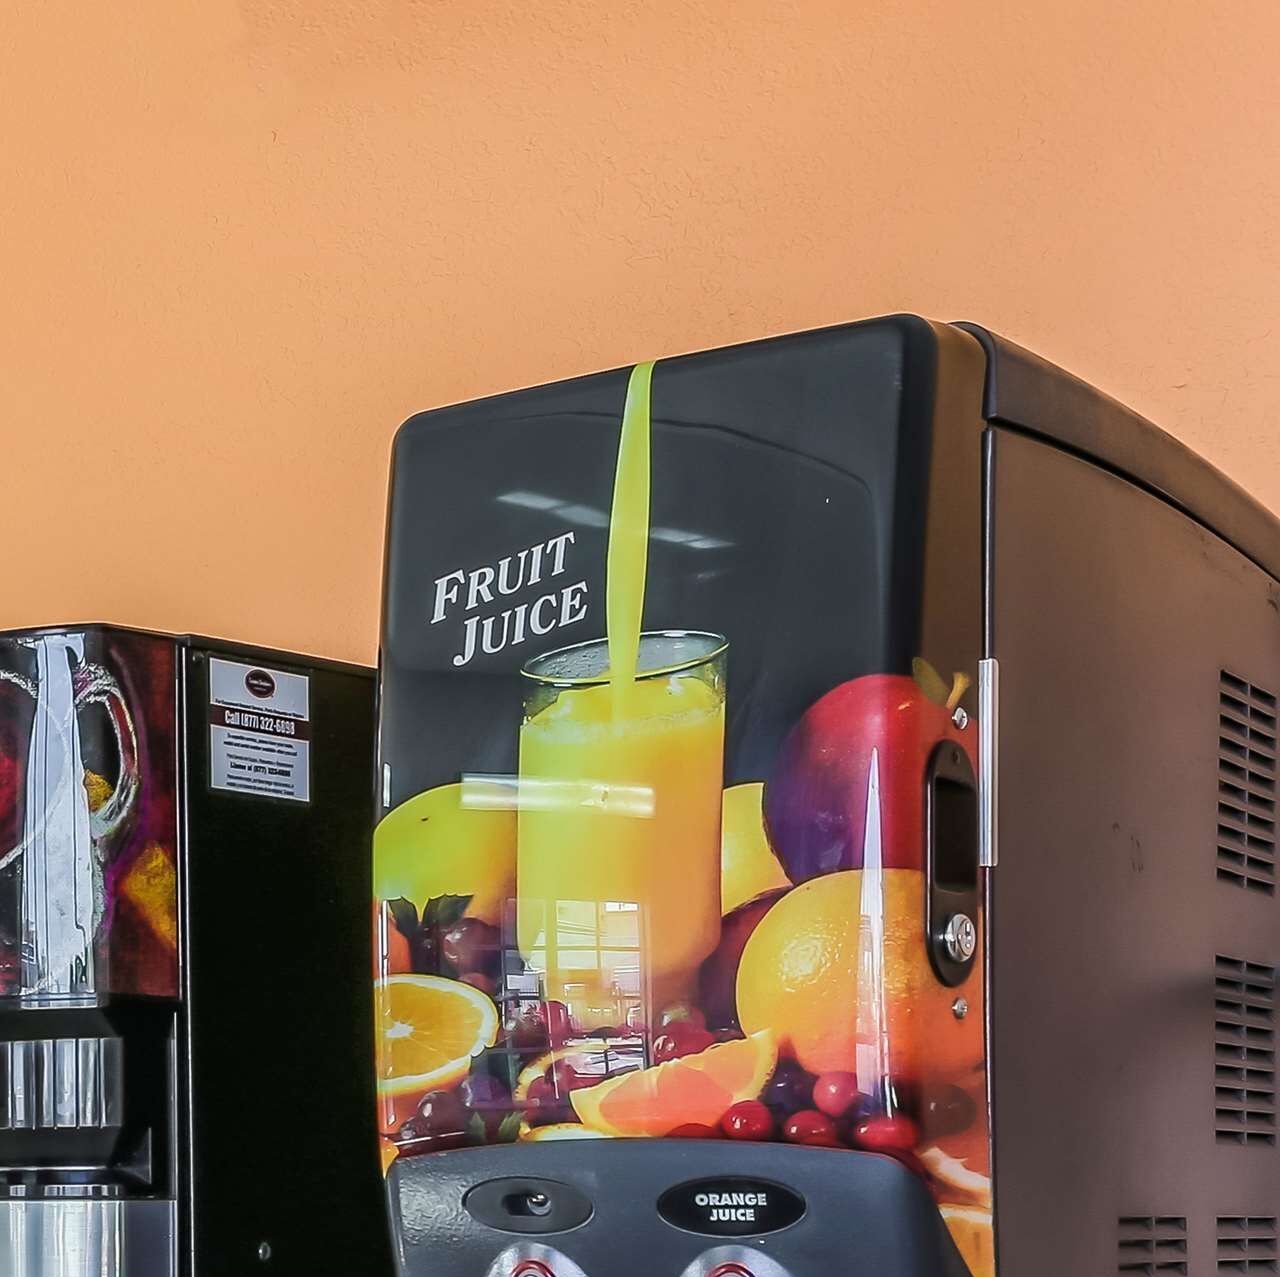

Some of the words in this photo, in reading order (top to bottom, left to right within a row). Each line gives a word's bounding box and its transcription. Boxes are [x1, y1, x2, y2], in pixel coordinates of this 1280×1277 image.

[430, 531, 576, 624] FRUIT
[452, 580, 589, 667] JUICE
[694, 1193, 767, 1207] ORANGE
[709, 1207, 756, 1222] JUICE
